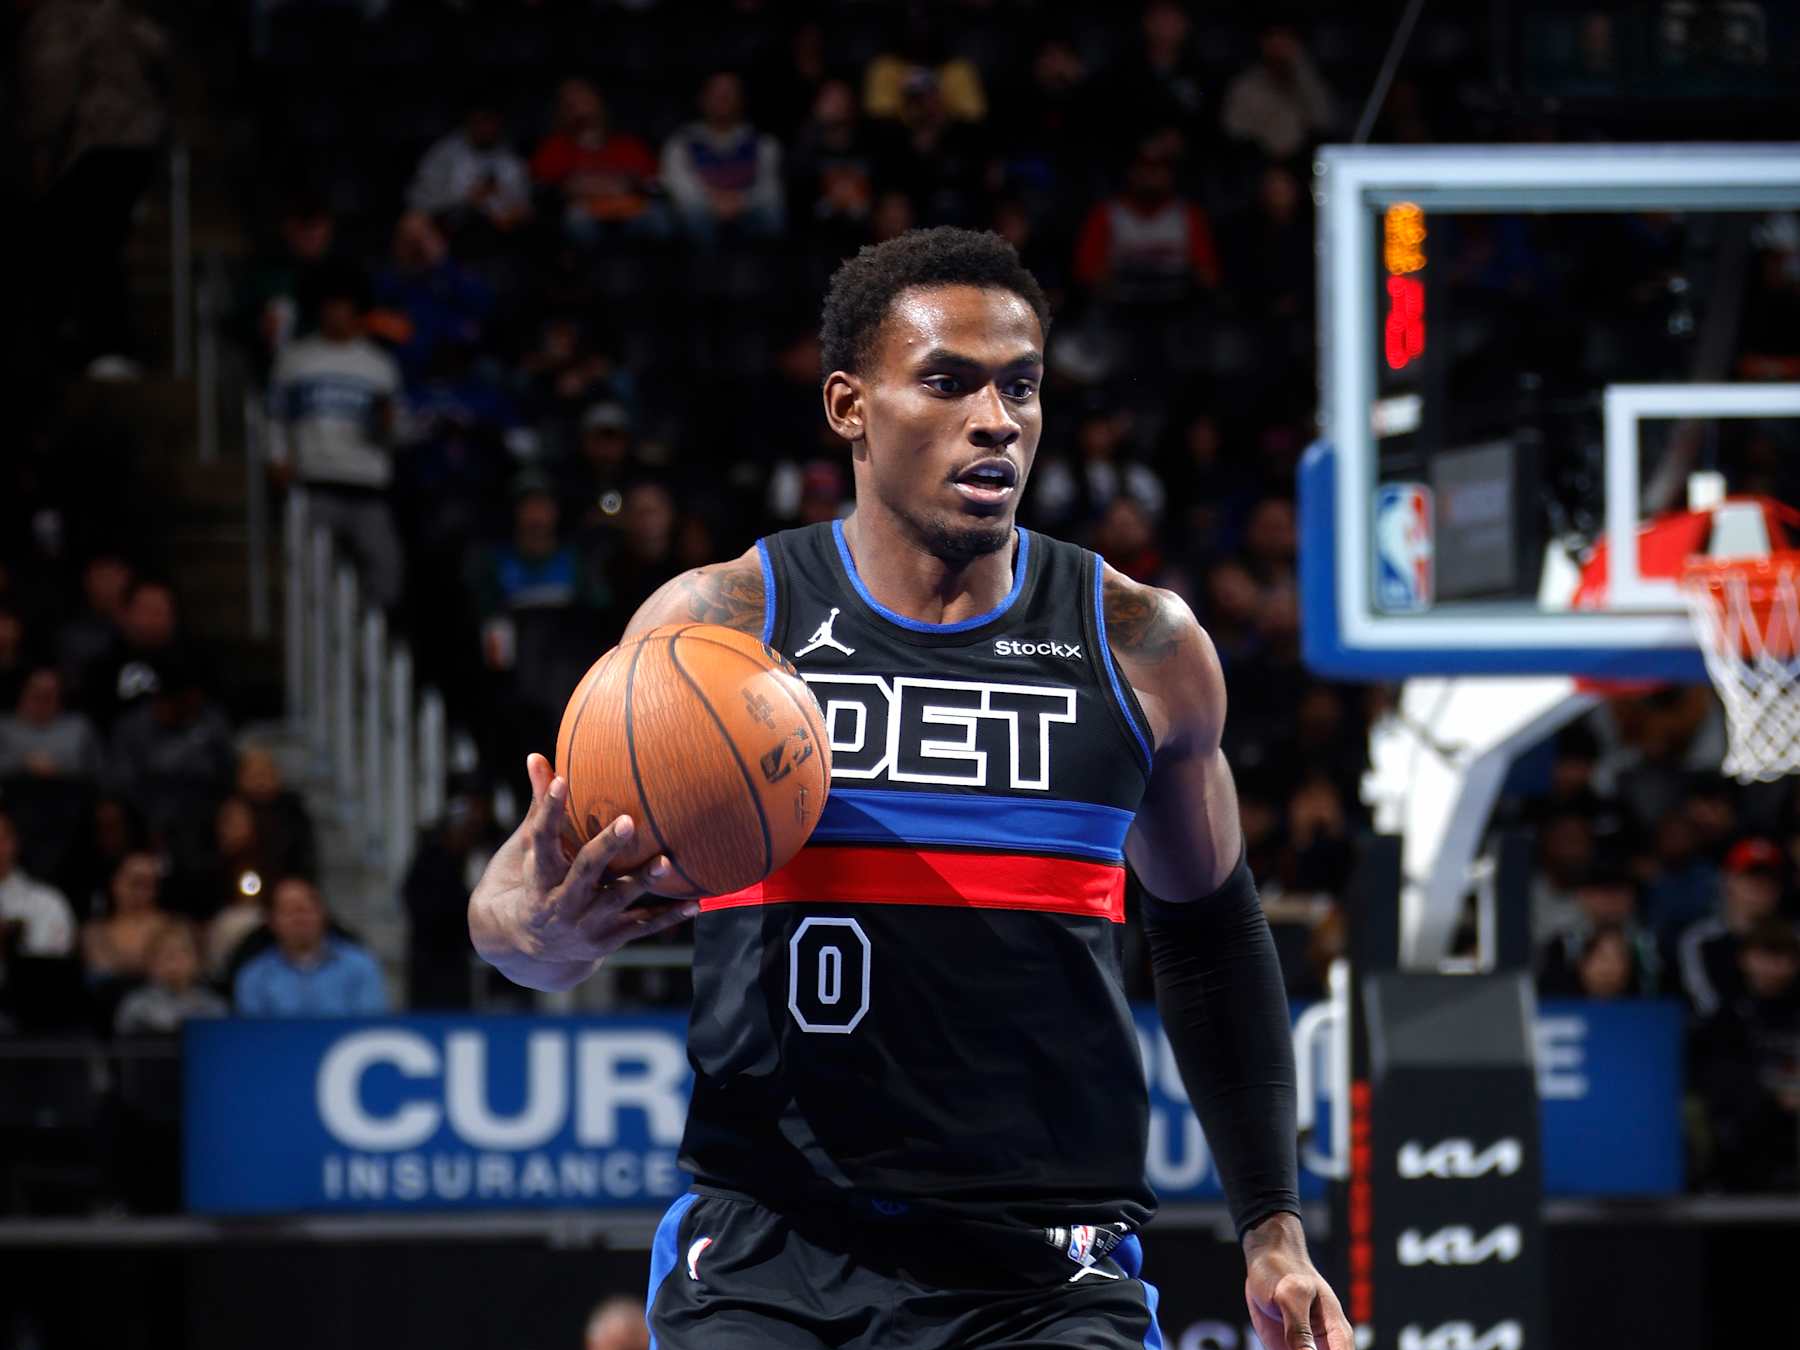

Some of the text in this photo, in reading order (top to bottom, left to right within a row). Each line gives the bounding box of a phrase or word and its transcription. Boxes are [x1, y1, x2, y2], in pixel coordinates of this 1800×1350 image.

[800, 672, 1077, 791] DET
[787, 917, 872, 1035] 0
[324, 1155, 683, 1200] INSURANCE
